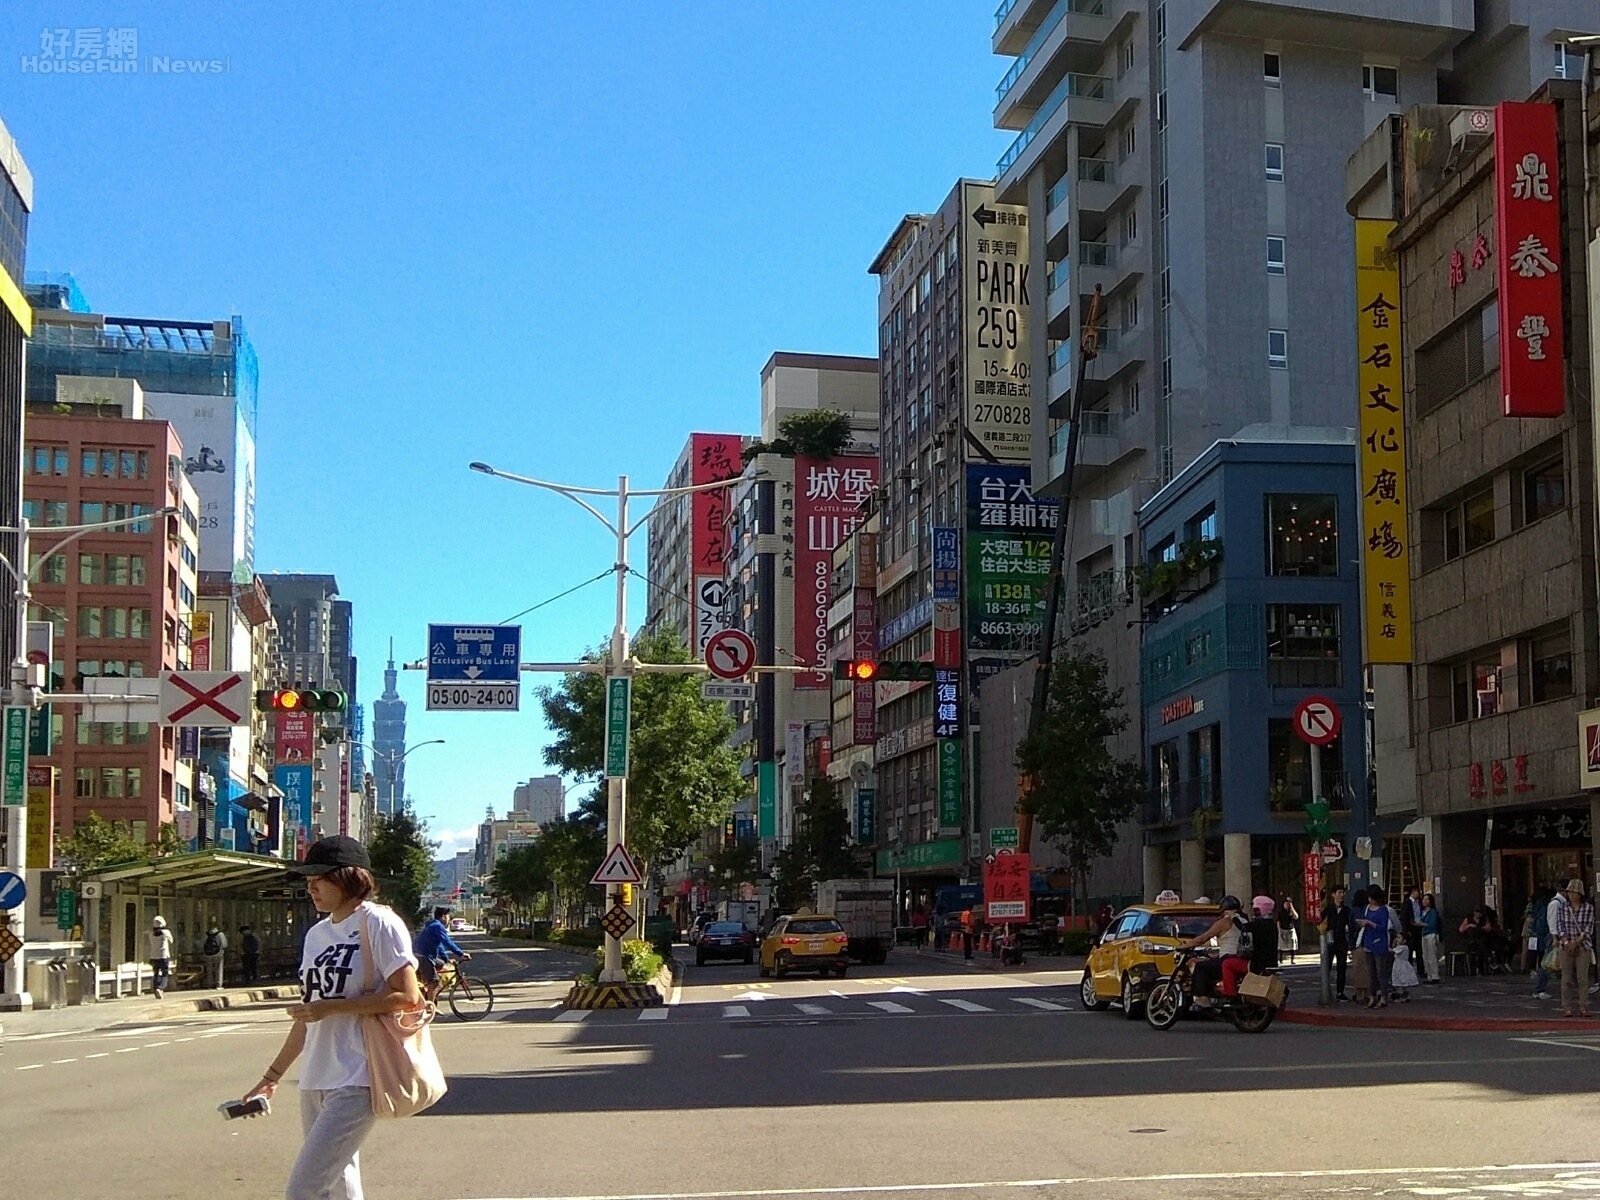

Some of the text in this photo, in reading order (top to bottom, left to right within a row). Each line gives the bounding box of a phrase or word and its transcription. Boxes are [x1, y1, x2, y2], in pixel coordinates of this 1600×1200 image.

[1512, 153, 1558, 360] 鼎泰豐
[977, 260, 1030, 305] PARK
[977, 306, 1017, 350] 259
[974, 380, 1031, 398] 國際酒店式
[974, 404, 1031, 425] 270828
[1360, 293, 1403, 559] 金石文化廣場
[806, 467, 873, 502] 城堡
[980, 477, 1035, 502] 台大
[980, 503, 1059, 527] 羅斯福
[980, 557, 1051, 574] 住台大生活
[815, 562, 828, 683] 8666-6655
[1379, 582, 1397, 638] 信義店
[432, 643, 516, 656] 公車專用
[432, 657, 515, 665] Exclusive Bus Lane
[432, 689, 514, 704] 05:00~24:00
[937, 684, 958, 720] 復健
[937, 724, 958, 735] 4F
[314, 943, 360, 968] GET
